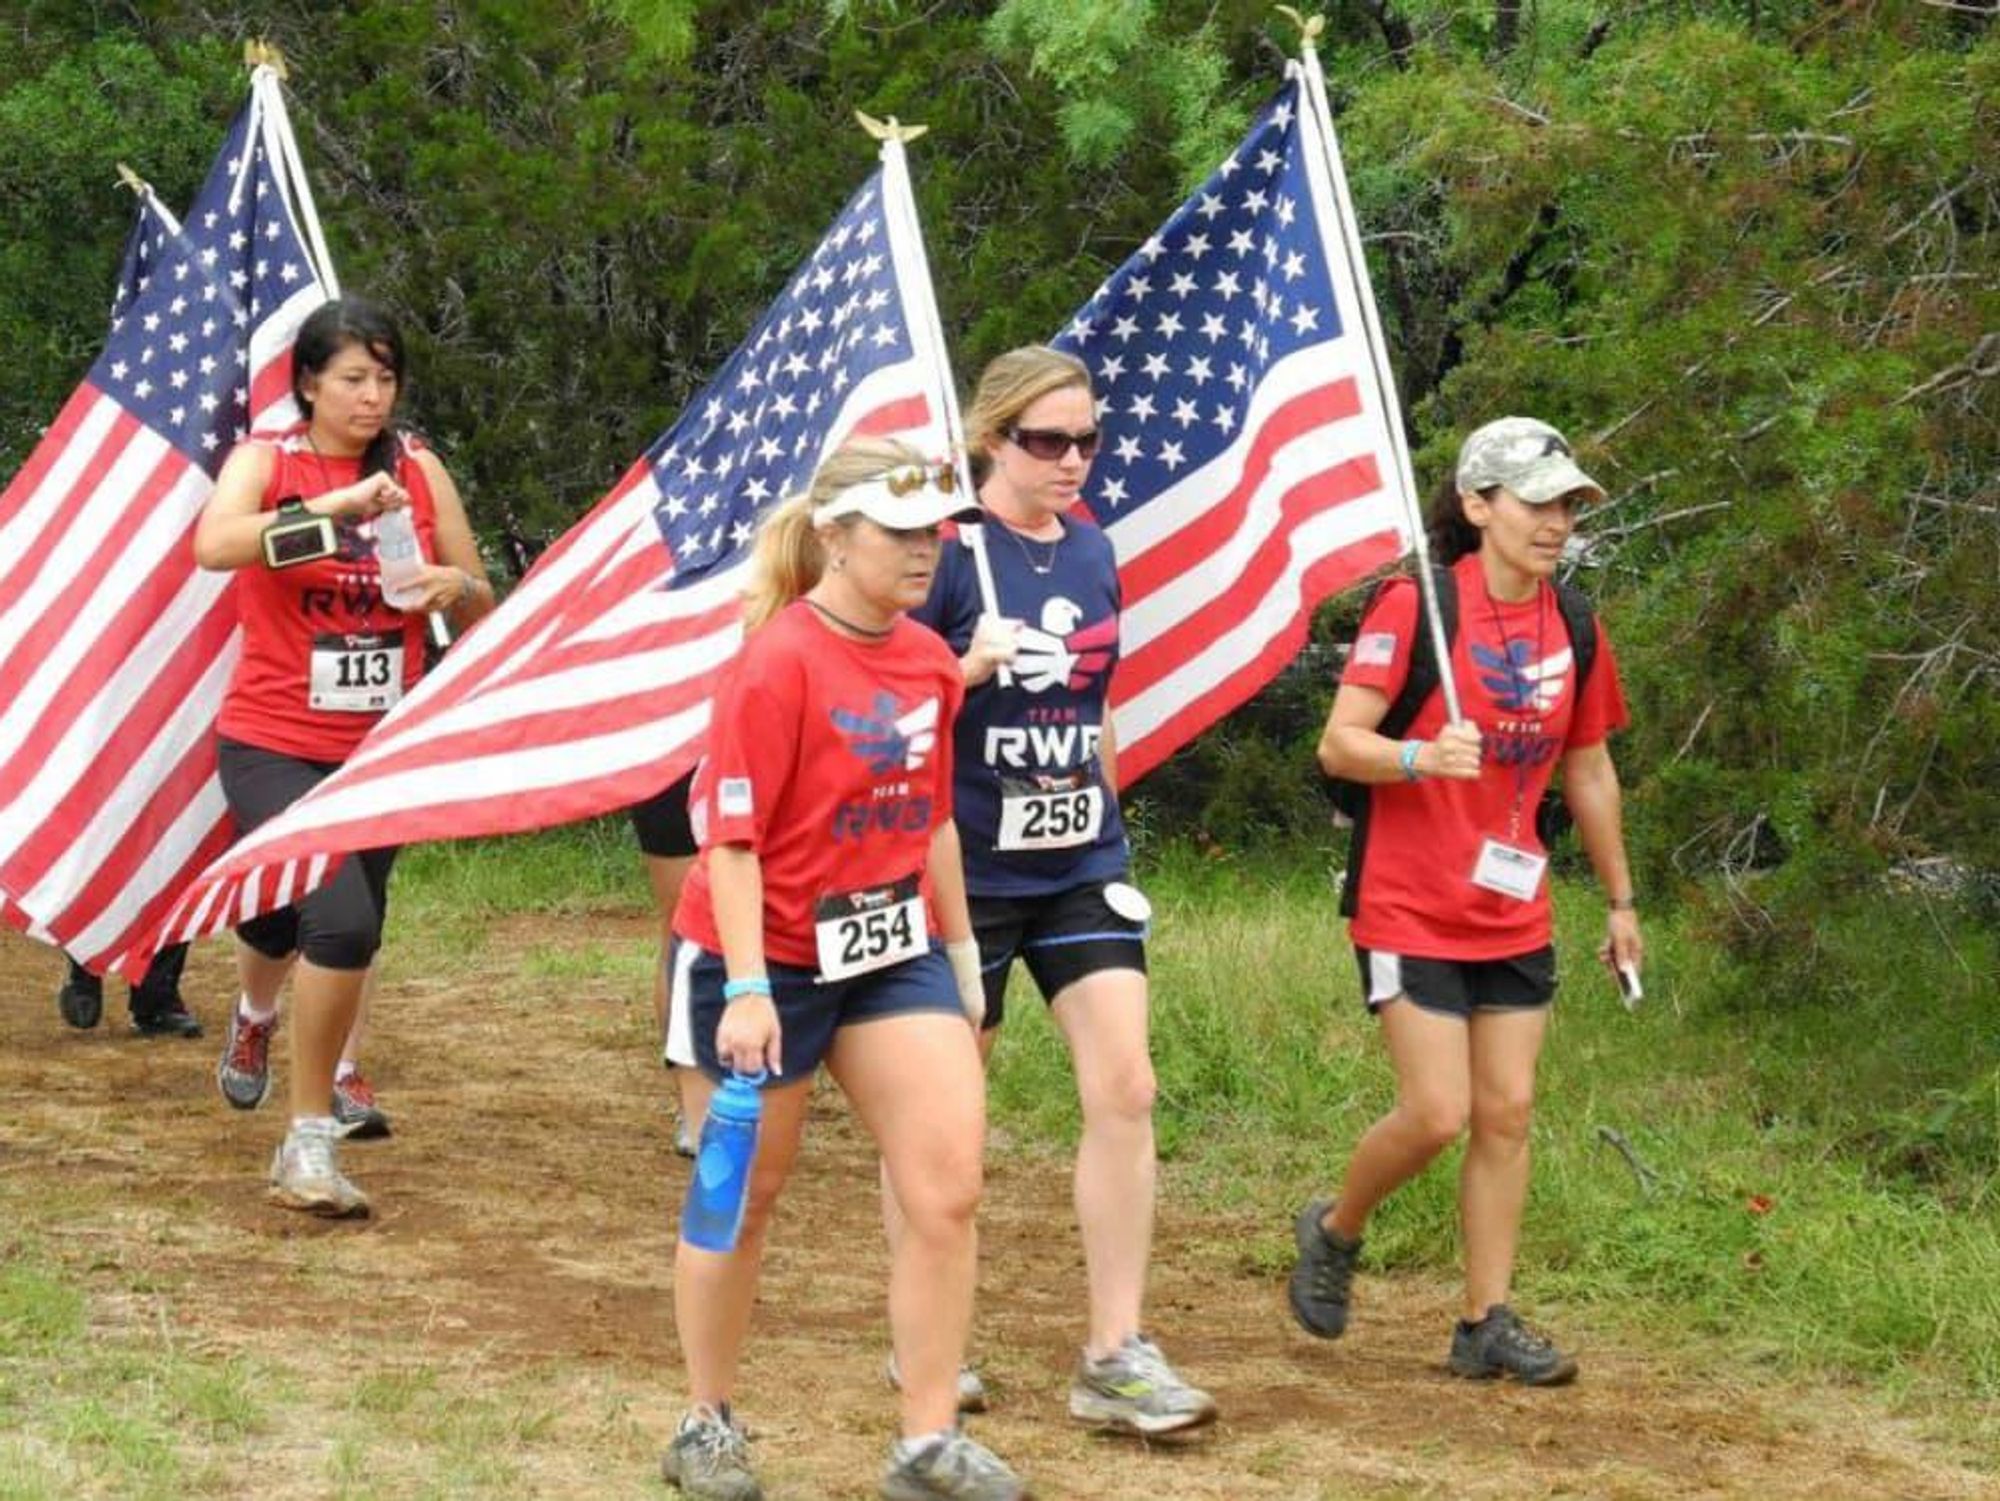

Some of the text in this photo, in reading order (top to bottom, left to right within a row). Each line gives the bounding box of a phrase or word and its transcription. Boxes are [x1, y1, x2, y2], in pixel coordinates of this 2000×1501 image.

[336, 652, 390, 688] 113
[1028, 708, 1078, 723] TEAM
[1022, 793, 1090, 839] 258
[839, 905, 913, 965] 254
